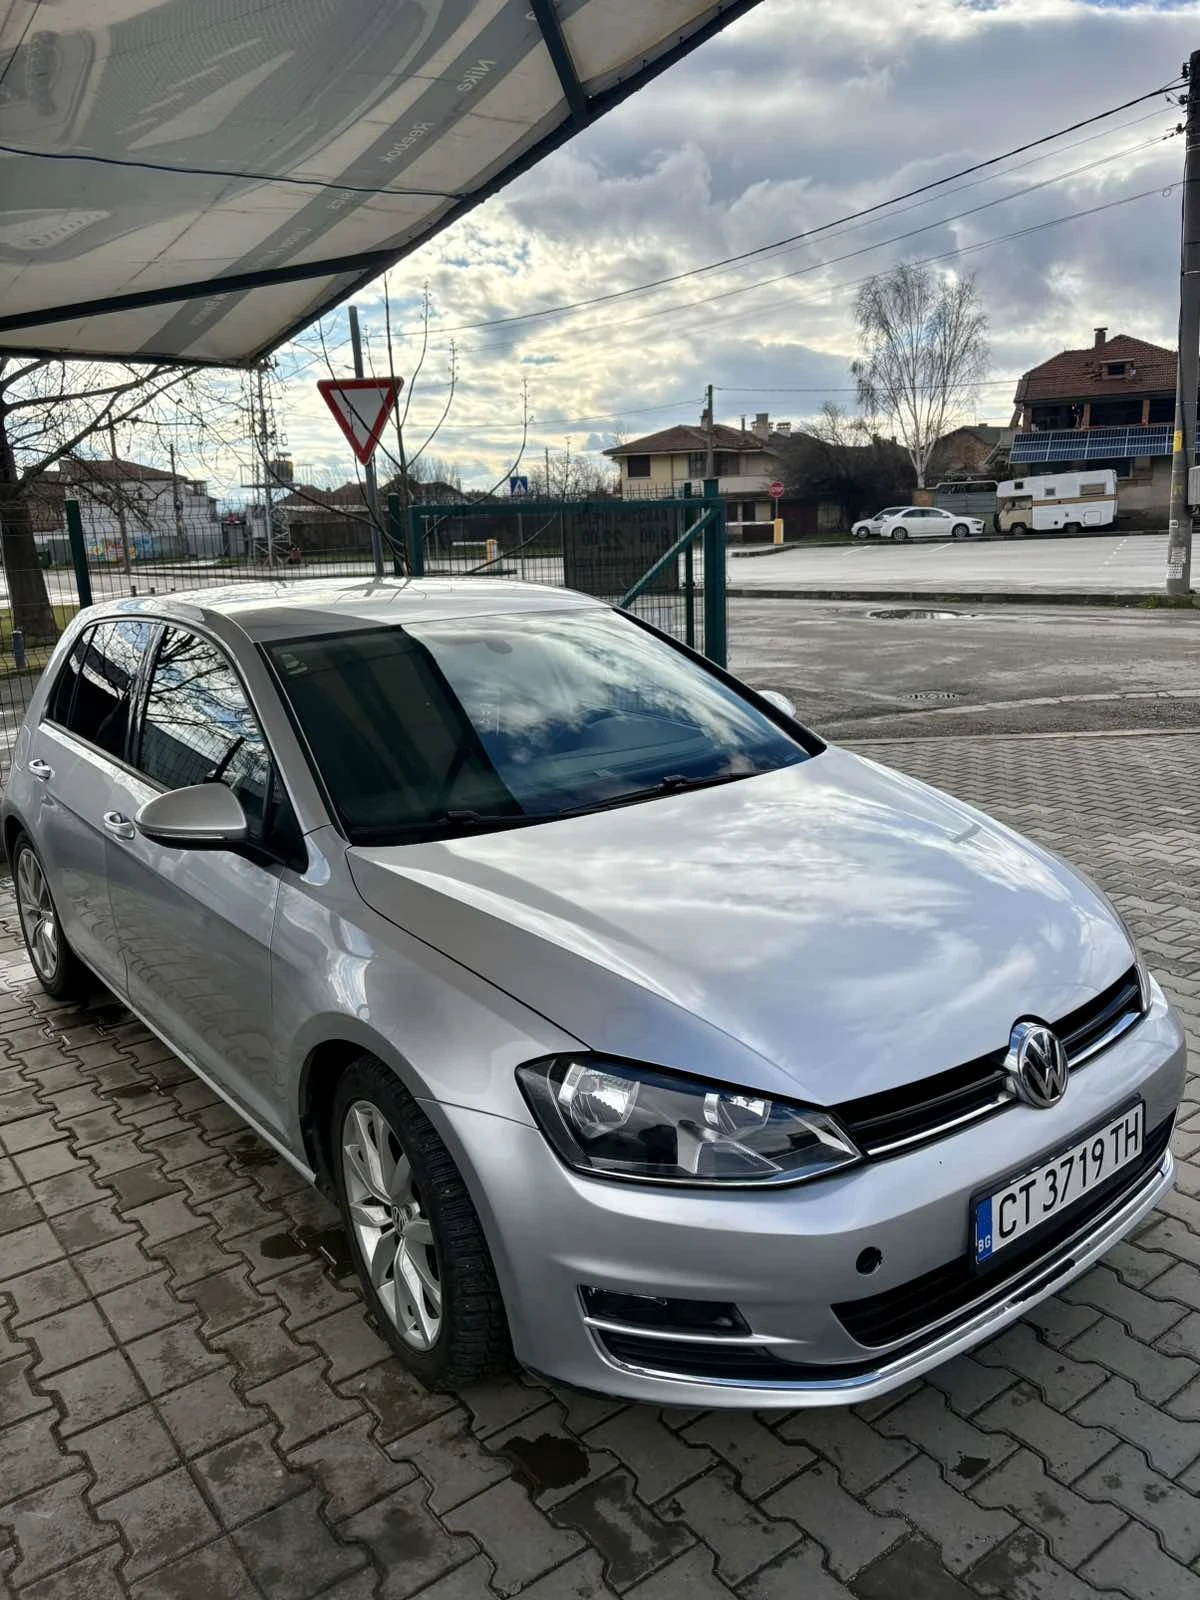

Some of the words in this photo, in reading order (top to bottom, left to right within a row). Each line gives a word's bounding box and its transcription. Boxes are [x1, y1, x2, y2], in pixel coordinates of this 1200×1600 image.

[1021, 1027, 1066, 1104] VW
[998, 1179, 1037, 1239] CT
[1043, 1137, 1105, 1212] 3719
[1110, 1112, 1139, 1165] TH
[977, 1235, 992, 1252] BG
